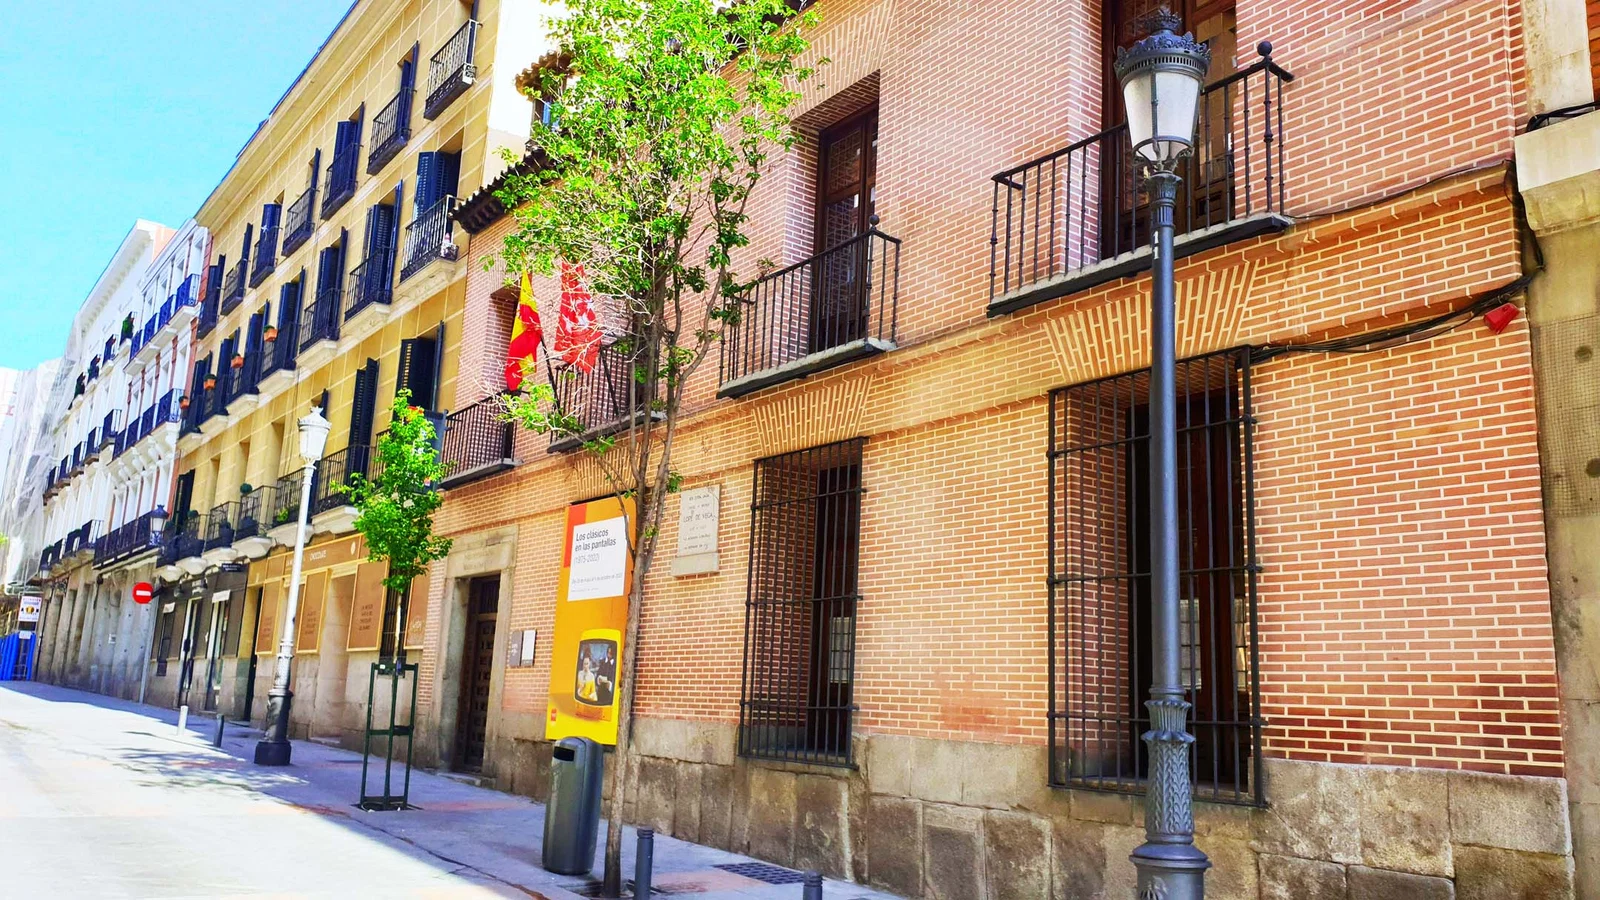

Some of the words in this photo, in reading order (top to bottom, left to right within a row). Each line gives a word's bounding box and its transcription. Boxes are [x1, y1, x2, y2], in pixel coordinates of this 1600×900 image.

[576, 532, 586, 542] Los
[582, 542, 590, 550] las
[591, 538, 616, 550] pantallas
